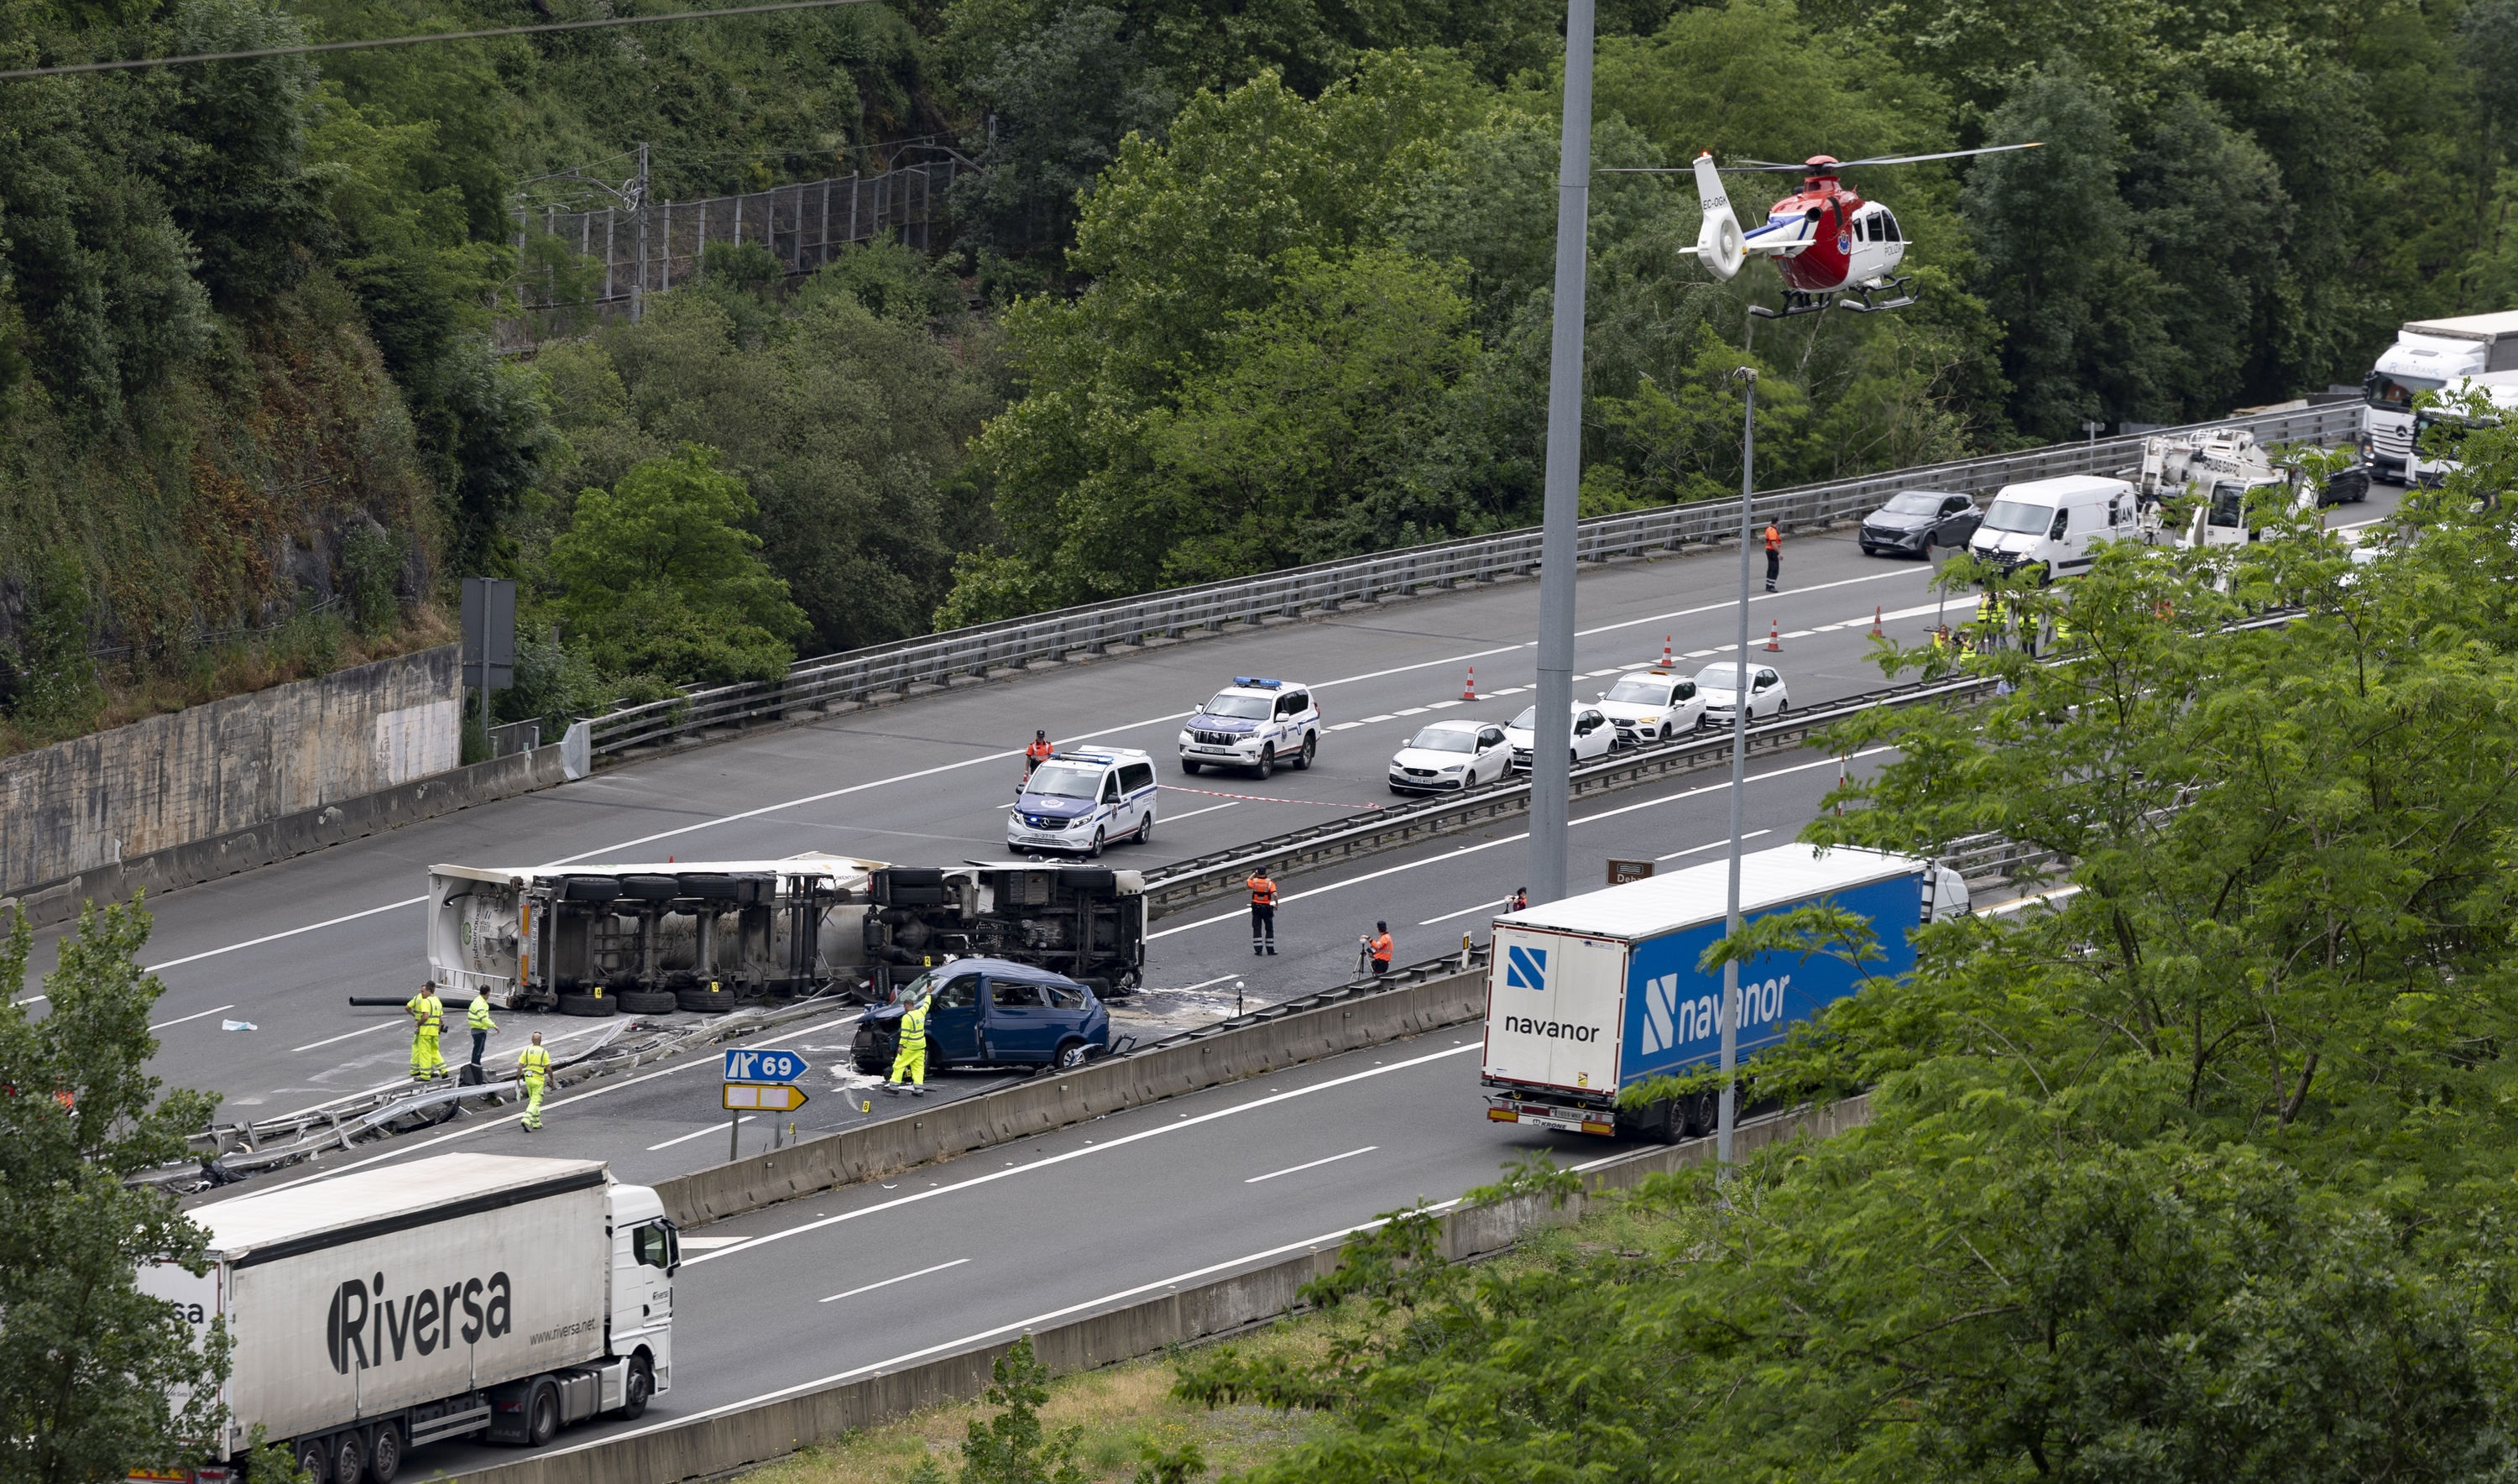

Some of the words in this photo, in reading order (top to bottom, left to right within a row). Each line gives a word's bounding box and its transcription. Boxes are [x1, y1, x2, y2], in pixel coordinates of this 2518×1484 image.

[1703, 195, 1729, 210] EC-OGK
[1884, 243, 1902, 258] POLIZIA
[2389, 362, 2440, 378] RISETRANS
[472, 913, 480, 959] labouriaux
[1506, 1015, 1600, 1043] navanor
[762, 1057, 791, 1076] 69
[1541, 1121, 1567, 1130] KRONE
[653, 1291, 669, 1301] Riversa
[327, 1271, 511, 1375] Riversa
[530, 1317, 595, 1346] www.riversa.net
